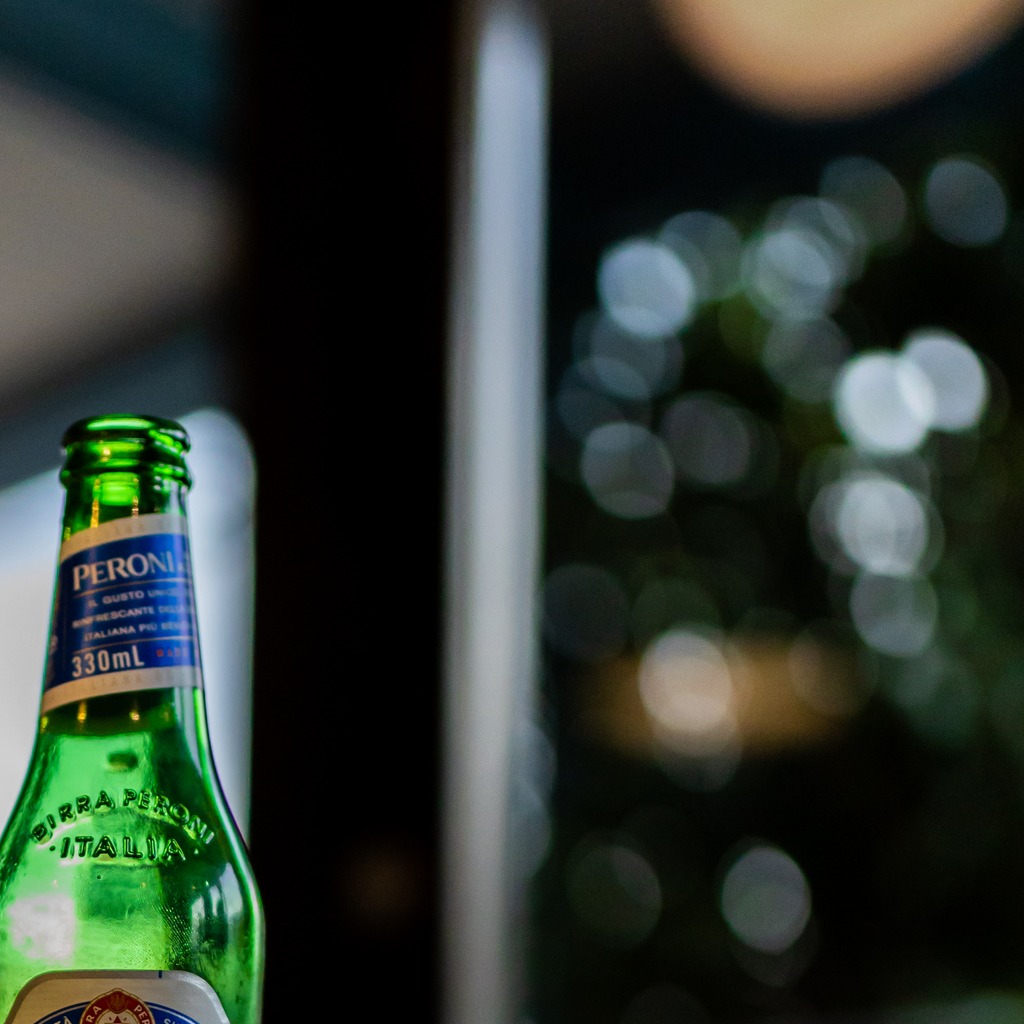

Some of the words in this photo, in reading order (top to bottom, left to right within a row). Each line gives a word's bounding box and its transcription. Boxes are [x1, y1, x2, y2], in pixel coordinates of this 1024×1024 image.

[73, 552, 174, 590] PERONI
[102, 590, 144, 604] GUSTO
[72, 645, 145, 678] 330mL
[30, 790, 115, 843] BIRRA
[123, 788, 215, 844] PERONI
[60, 835, 186, 861] ITALIA
